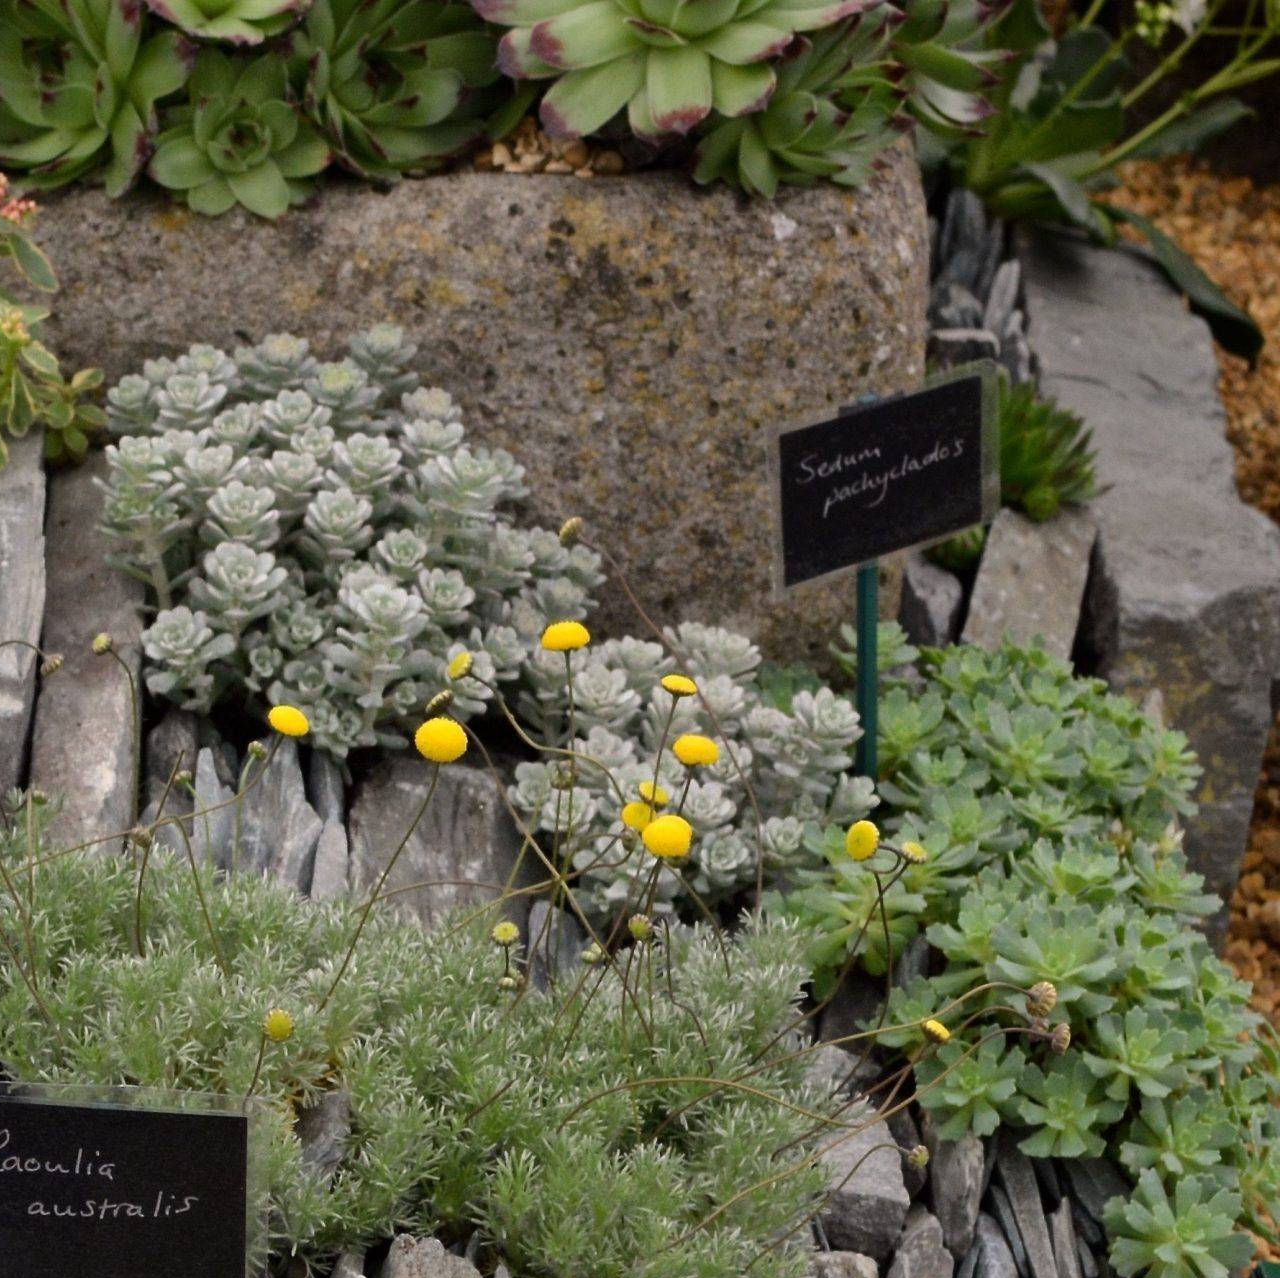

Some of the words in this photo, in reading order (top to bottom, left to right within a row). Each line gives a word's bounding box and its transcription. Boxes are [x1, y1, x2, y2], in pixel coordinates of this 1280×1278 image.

[795, 447, 881, 484] Sedum
[822, 438, 965, 519] pachyclados
[27, 1191, 199, 1221] australis
